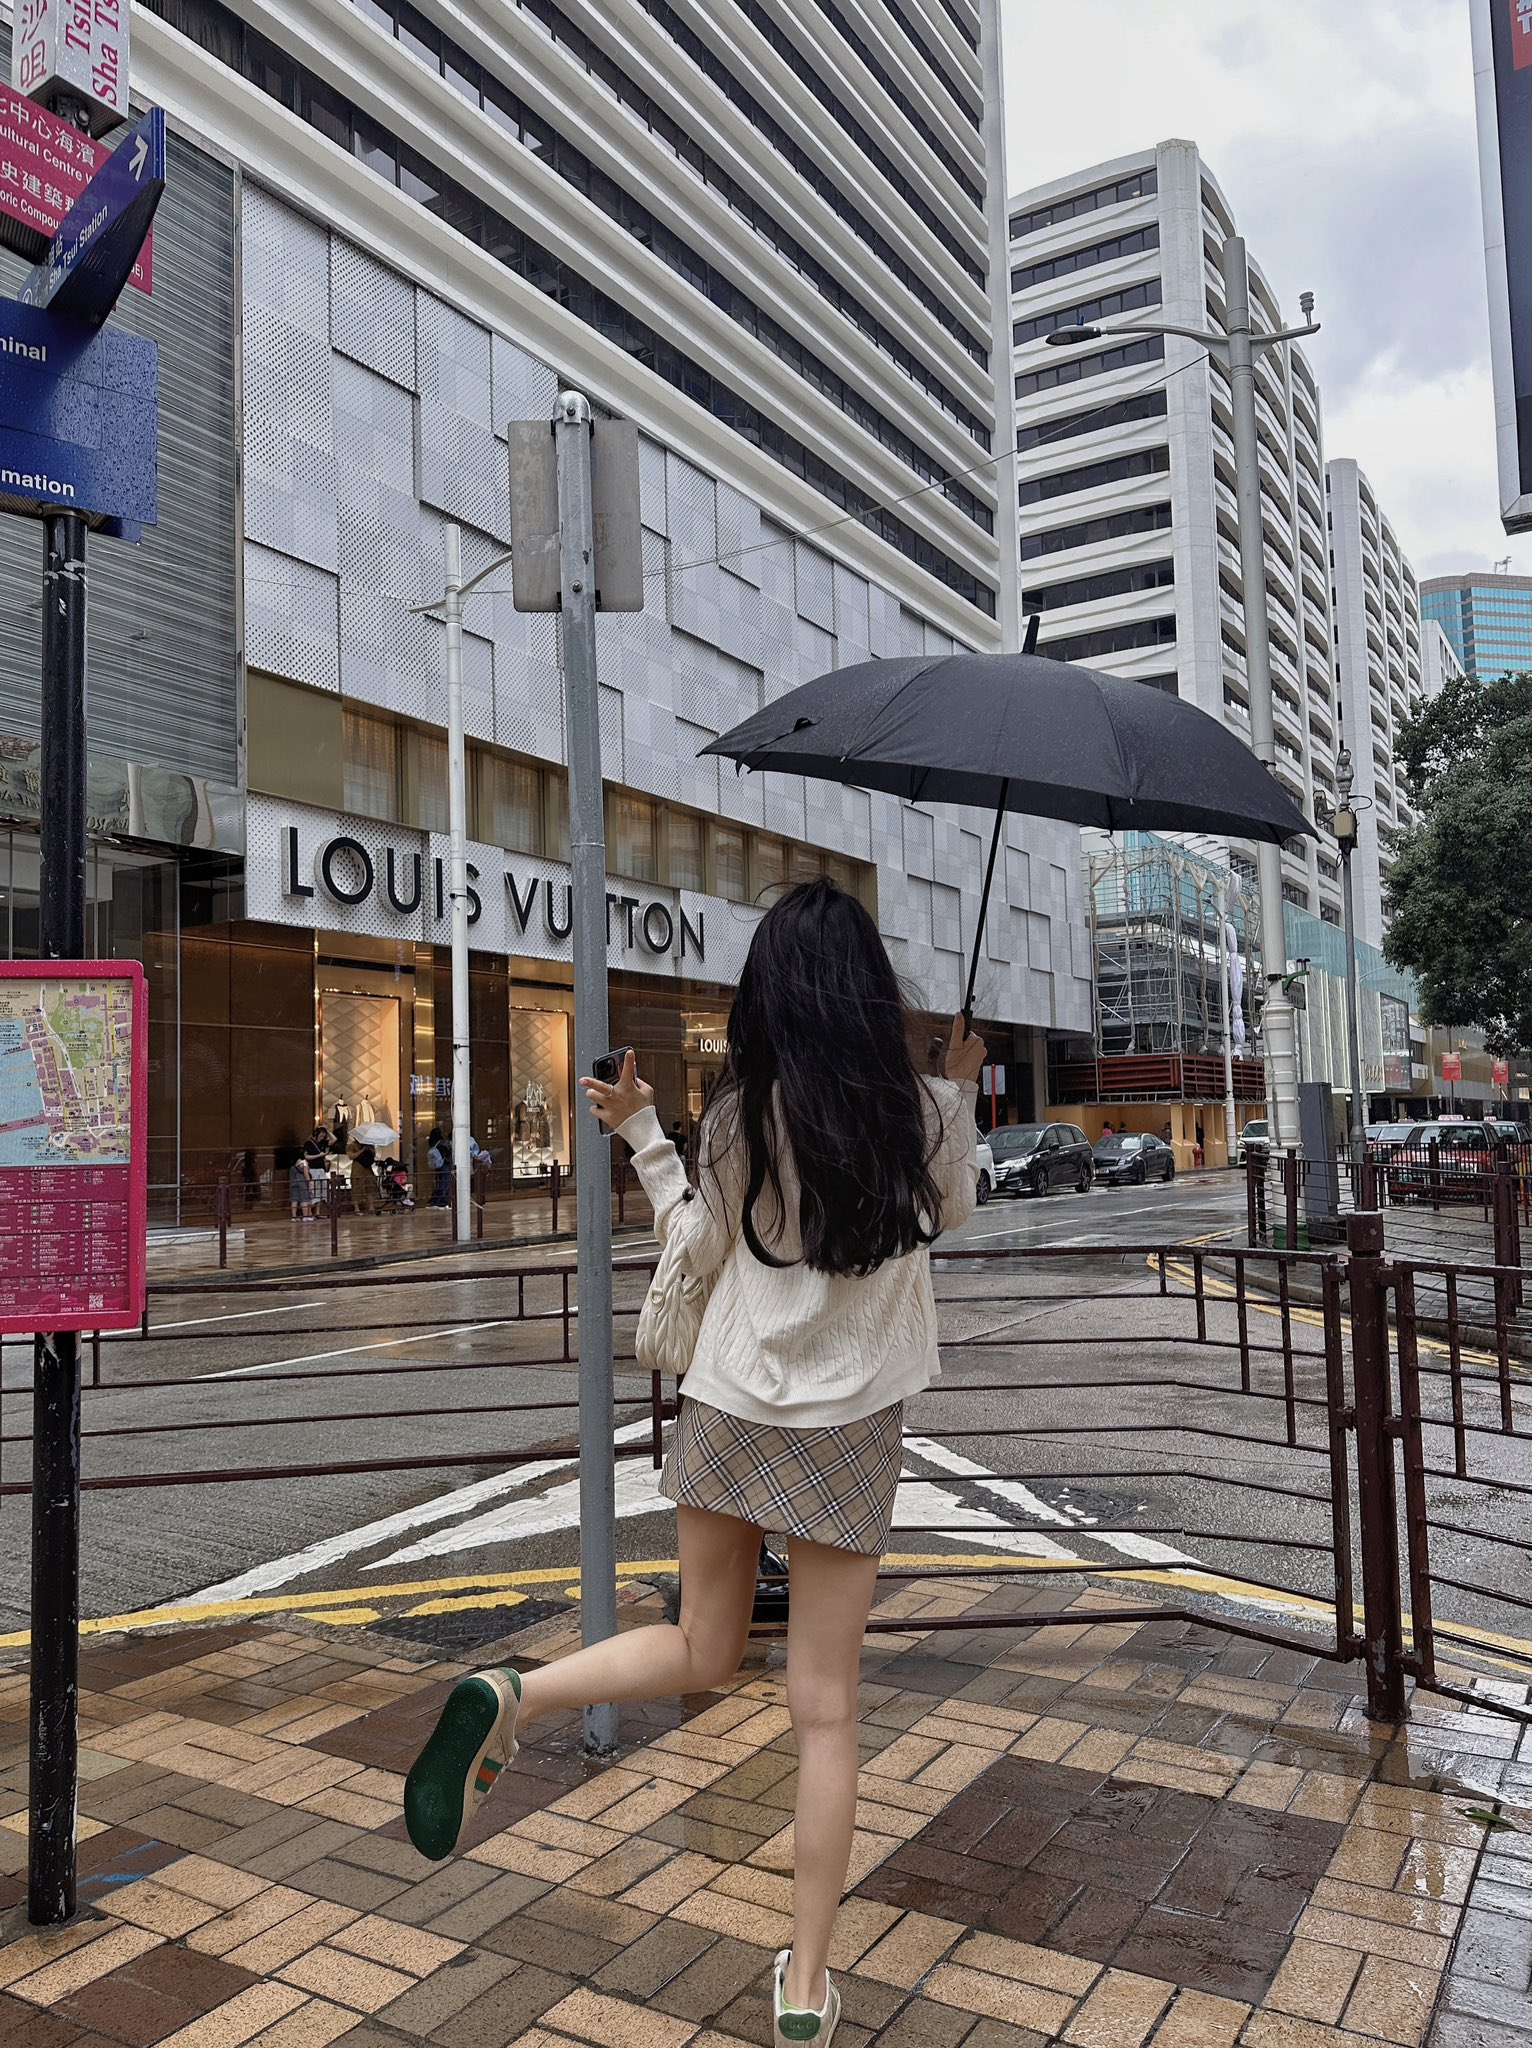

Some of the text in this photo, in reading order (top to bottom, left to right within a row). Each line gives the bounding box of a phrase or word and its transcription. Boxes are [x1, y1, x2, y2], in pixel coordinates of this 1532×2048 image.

[65, 0, 92, 55] Tsi
[92, 43, 119, 107] Sha
[43, 148, 83, 181] Centre
[20, 199, 61, 230] Compou
[63, 237, 79, 269] Tsui
[79, 204, 109, 248] Station
[0, 466, 75, 498] mation
[281, 826, 705, 963] LOUIS VUTTON
